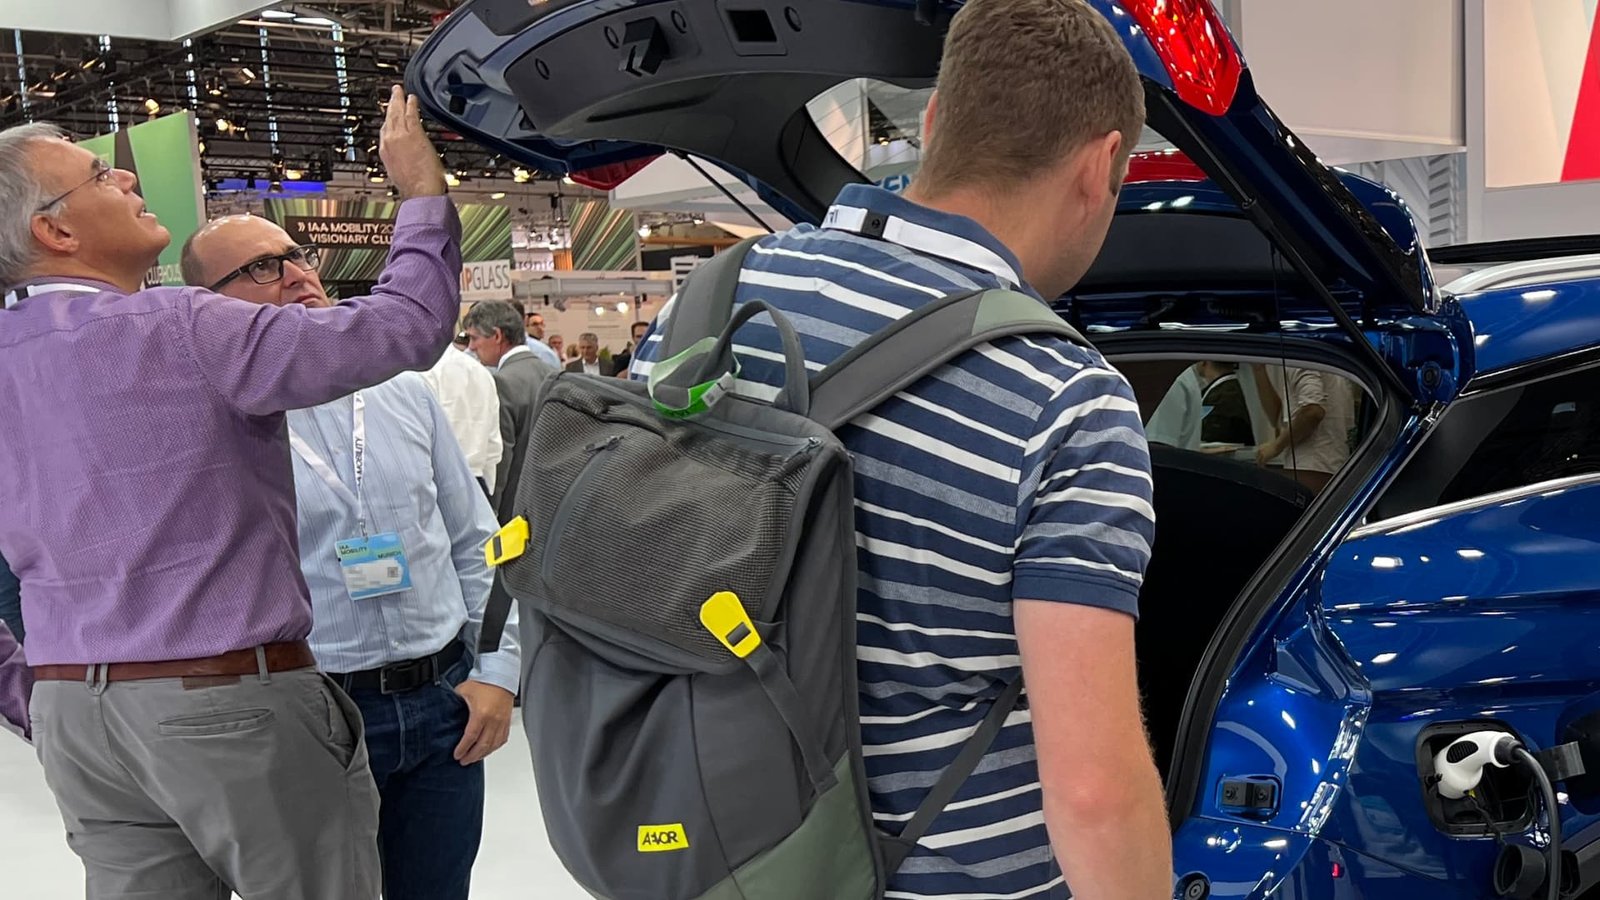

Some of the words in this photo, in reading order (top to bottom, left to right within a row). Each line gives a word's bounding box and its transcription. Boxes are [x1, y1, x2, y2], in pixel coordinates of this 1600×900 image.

[308, 222, 329, 232] IAA
[330, 222, 379, 234] MOBILITY
[309, 233, 369, 245] VISIONARY
[341, 546, 367, 555] MOBILITY
[378, 551, 402, 559] MUNICH
